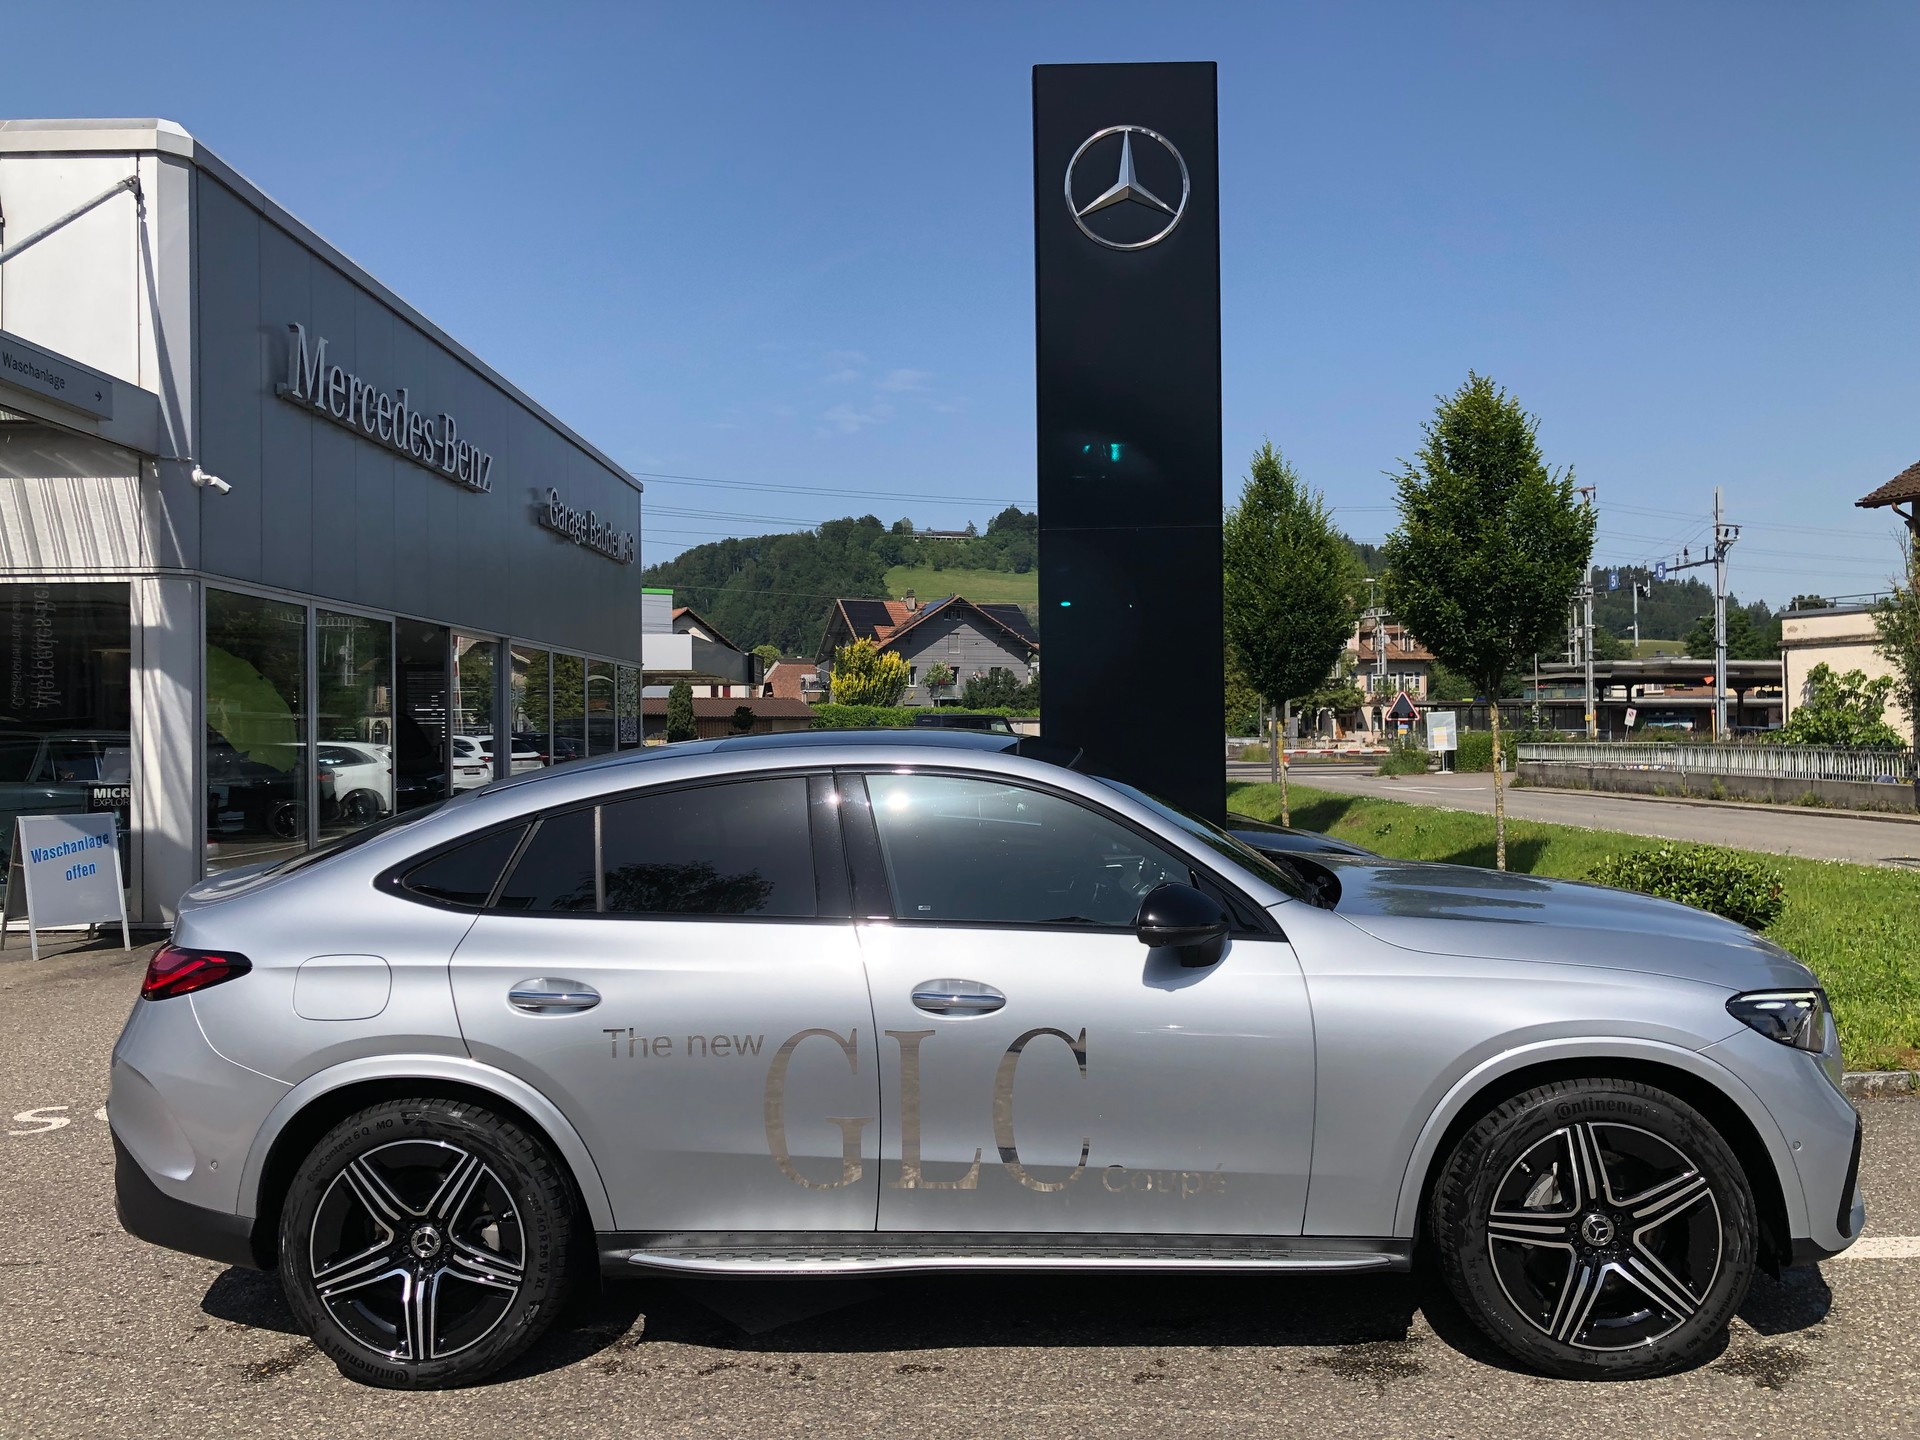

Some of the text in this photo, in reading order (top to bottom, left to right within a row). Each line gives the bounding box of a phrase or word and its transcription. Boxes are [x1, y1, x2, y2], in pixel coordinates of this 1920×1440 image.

[2, 351, 66, 391] Waschanlage
[290, 321, 494, 494] Mercedes-Benz
[549, 487, 588, 545] Garage
[1610, 575, 1617, 588] 5
[1657, 565, 1664, 578] 6
[31, 833, 110, 864] Waschanlage
[66, 862, 97, 881] offen
[603, 1028, 672, 1058] The
[687, 1034, 764, 1058] new
[764, 1027, 1090, 1192] GLC
[1554, 1097, 1650, 1121] Continental
[376, 1119, 393, 1130] MO
